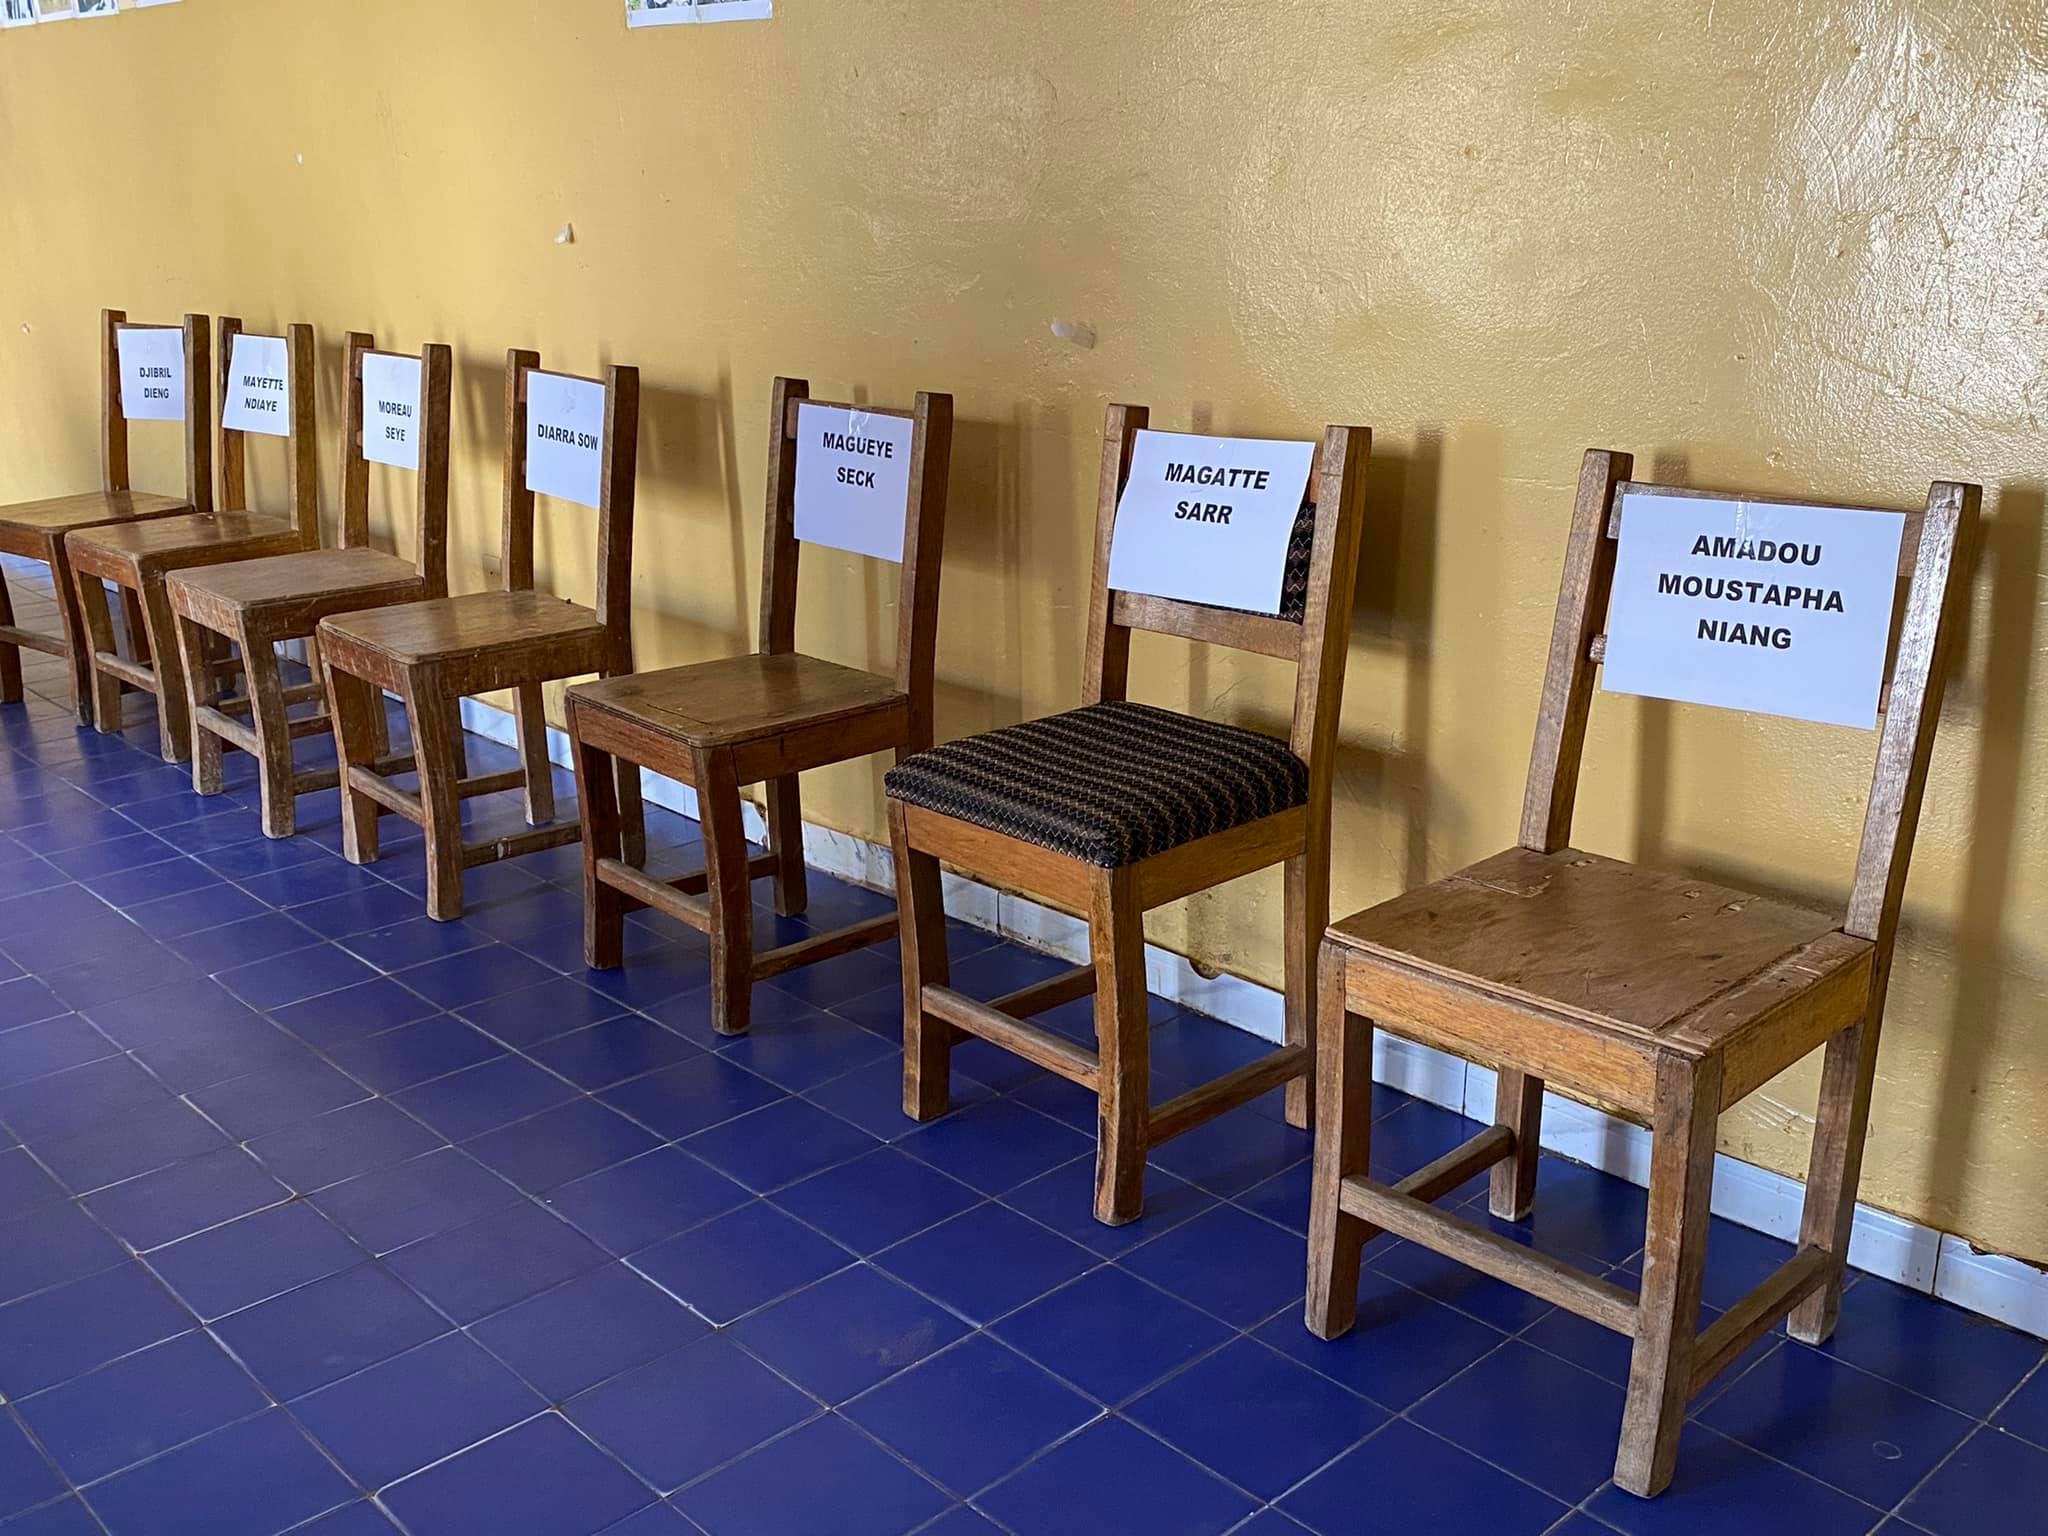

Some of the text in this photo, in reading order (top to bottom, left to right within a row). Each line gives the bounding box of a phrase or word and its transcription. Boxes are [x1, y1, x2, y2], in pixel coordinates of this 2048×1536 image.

[139, 367, 172, 378] DJIBRIL
[243, 375, 283, 391] MAYETTE
[144, 387, 169, 399] DIENG
[244, 397, 278, 412] NDIAYE
[378, 401, 412, 418] MOREAU
[386, 426, 405, 442] SEYE
[537, 423, 598, 451] DIARRA SOW
[822, 431, 893, 459] MAGUEYE
[836, 466, 876, 489] SECK
[1164, 462, 1270, 490] MAGATTE
[1174, 500, 1233, 525] SARR
[1691, 535, 1822, 566] AMADOU
[1658, 573, 1844, 613] MOUSTAPHA
[1697, 619, 1792, 650] NIANG
